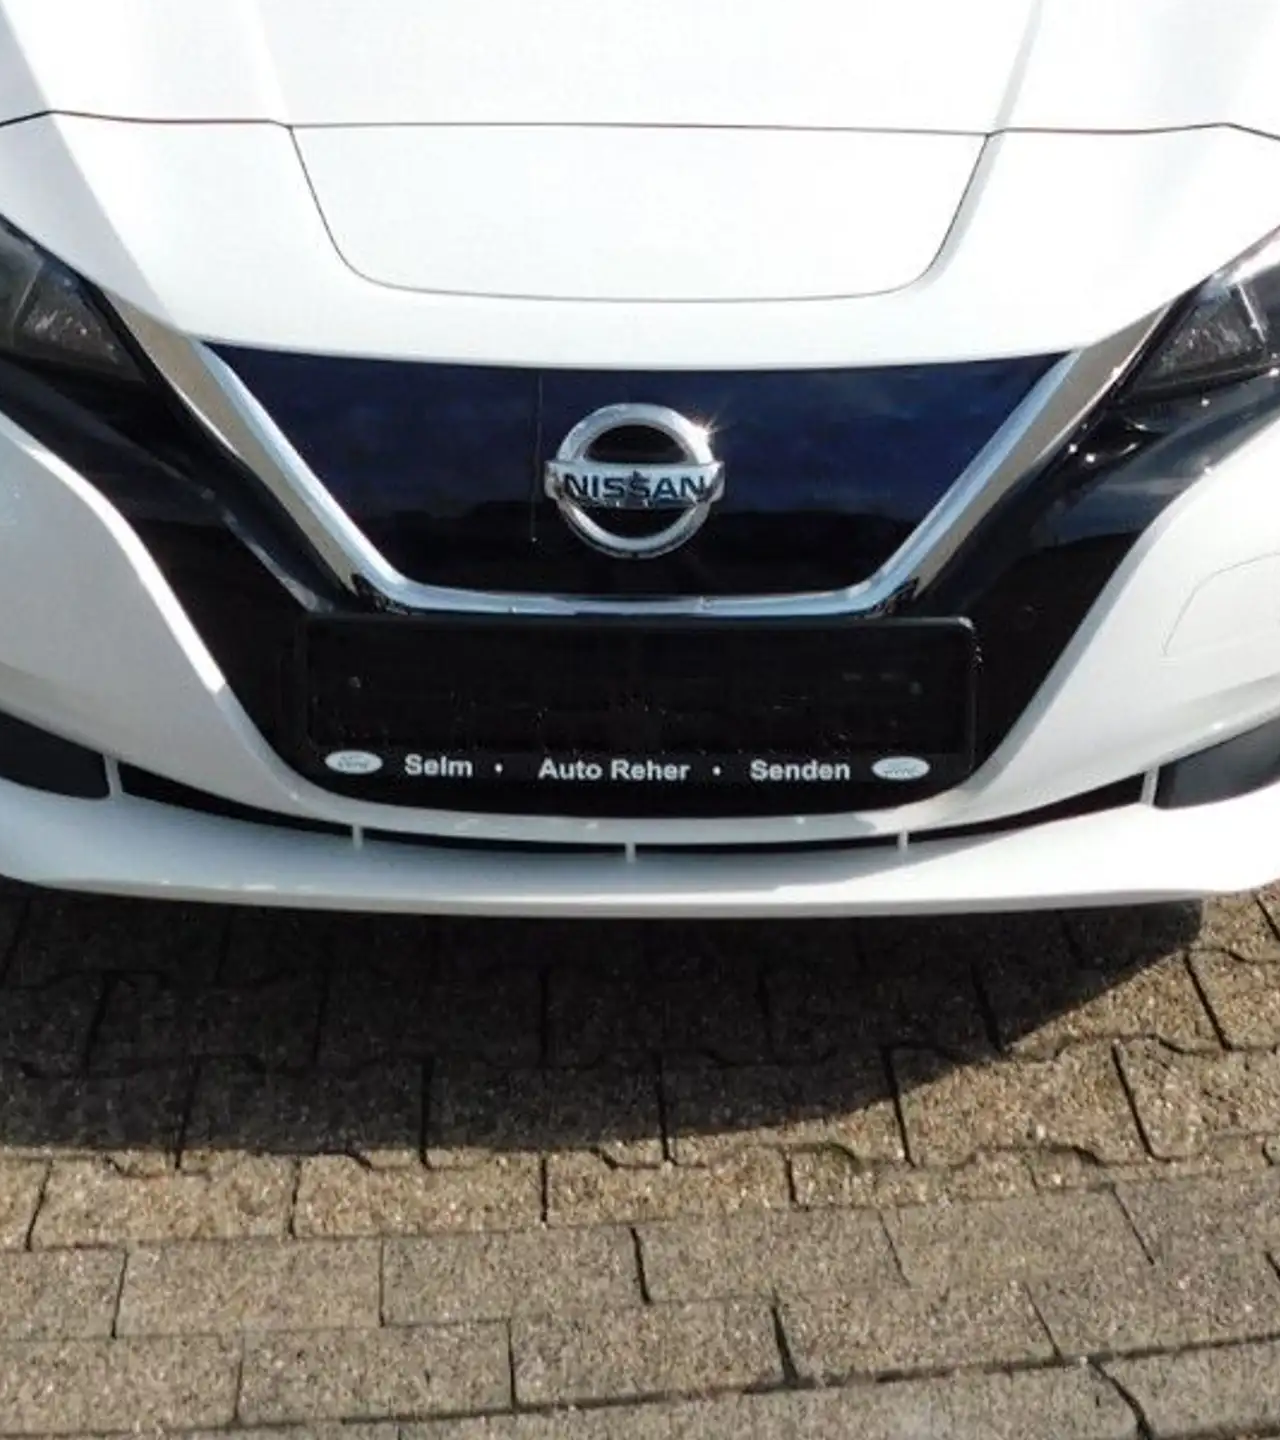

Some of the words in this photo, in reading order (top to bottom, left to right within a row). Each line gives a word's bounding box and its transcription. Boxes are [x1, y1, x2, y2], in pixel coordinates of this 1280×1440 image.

[563, 471, 706, 500] NISSAN
[404, 753, 473, 777] Selm
[538, 757, 603, 781] Auto
[610, 757, 691, 781] Reher
[749, 757, 852, 782] Senden
